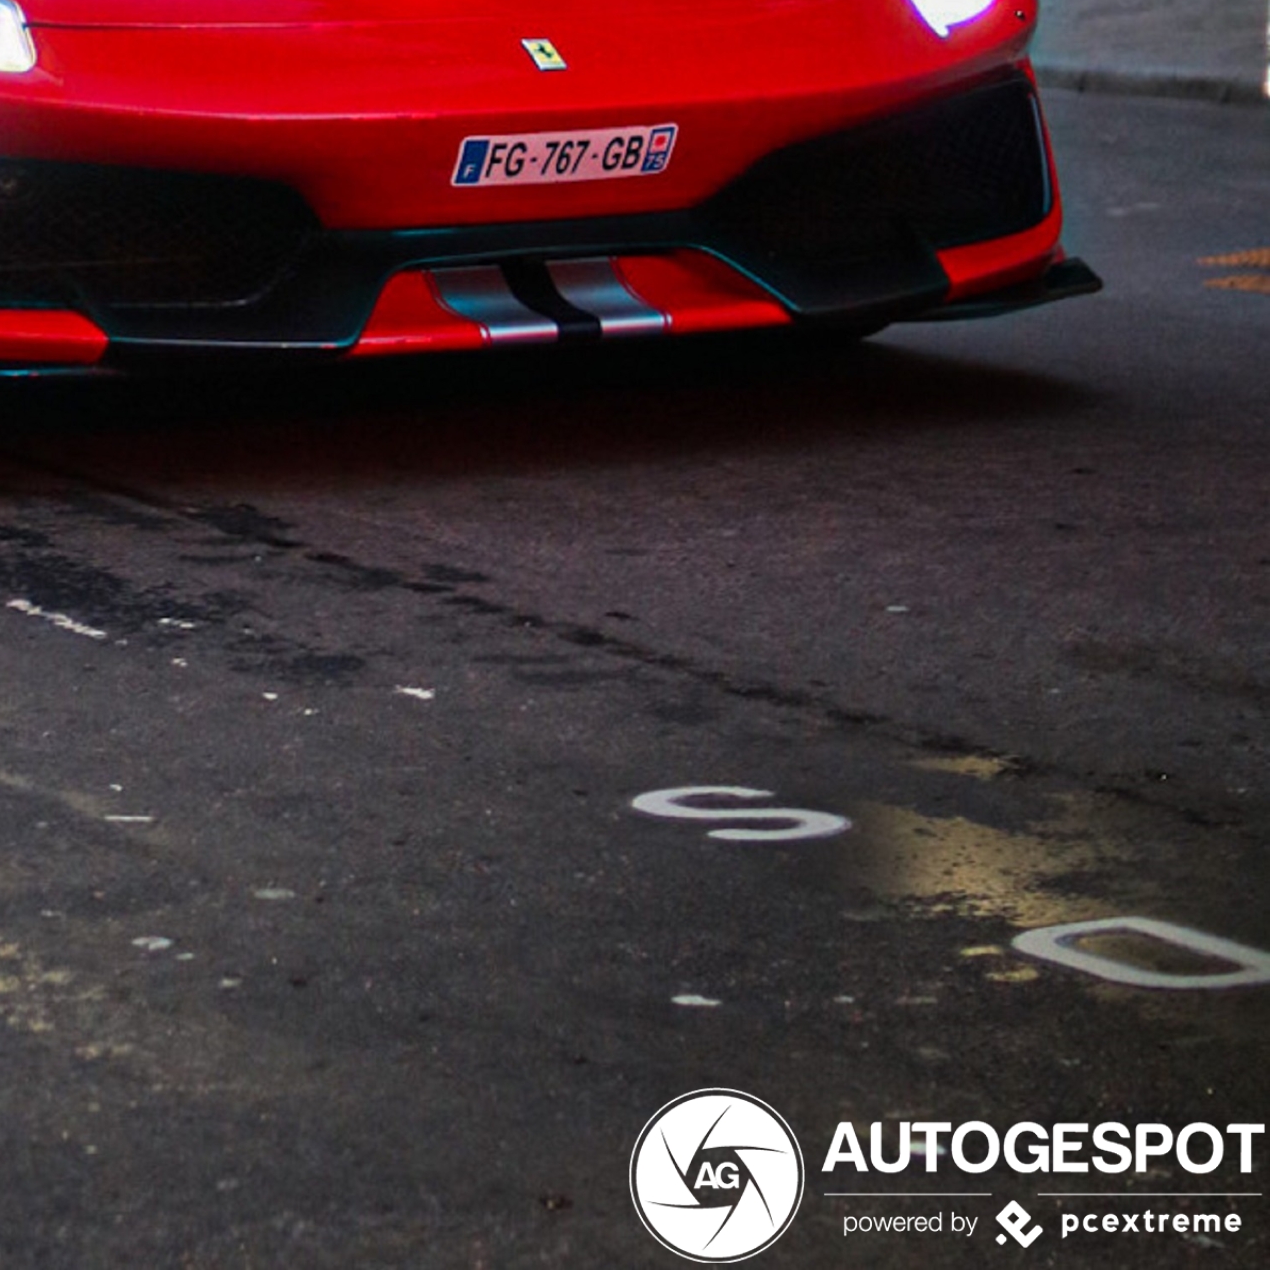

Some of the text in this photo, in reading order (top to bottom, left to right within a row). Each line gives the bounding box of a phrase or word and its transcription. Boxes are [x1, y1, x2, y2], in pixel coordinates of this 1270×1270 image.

[463, 135, 665, 179] F FG-767-GB 75
